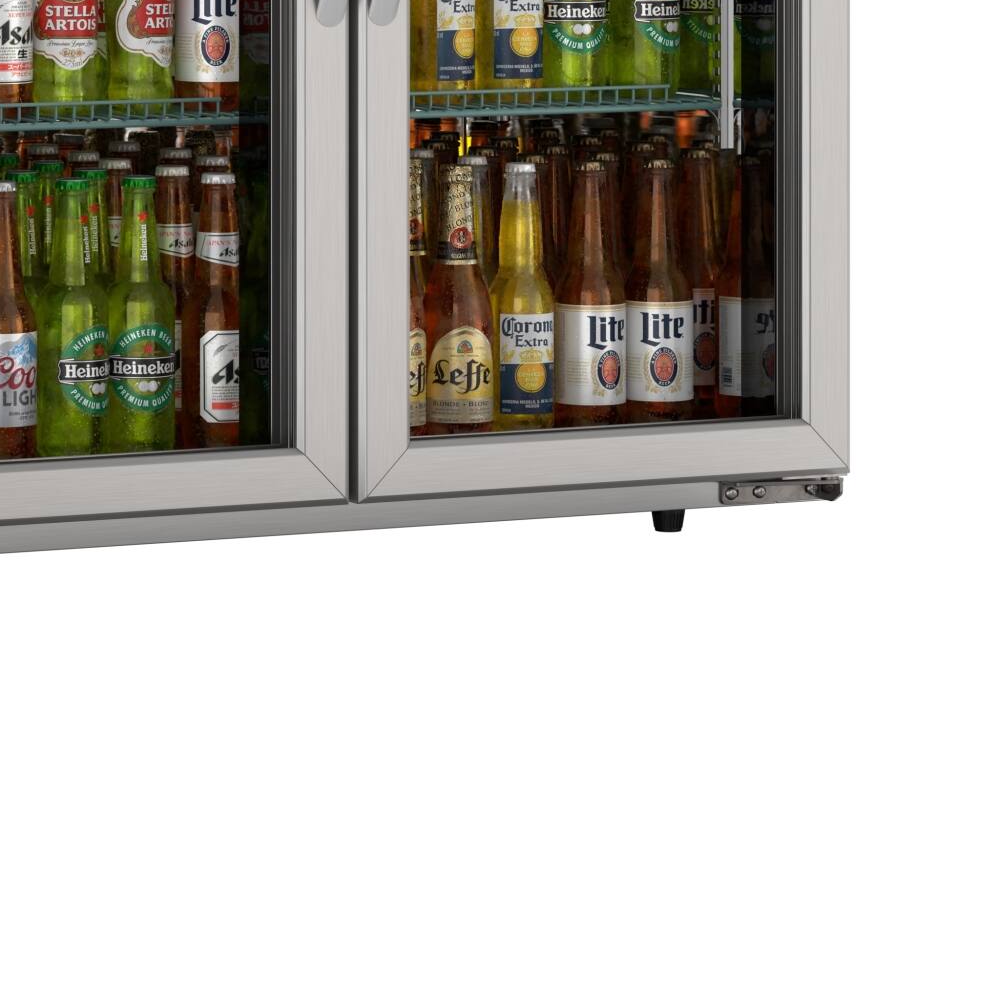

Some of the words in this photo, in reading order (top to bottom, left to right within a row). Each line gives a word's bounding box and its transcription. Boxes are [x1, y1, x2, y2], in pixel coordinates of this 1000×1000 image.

[45, 4, 96, 17] STELLA
[509, 0, 540, 12] Extra
[44, 18, 96, 31] ARTOIS
[552, 27, 584, 49] PREMIUM
[120, 328, 156, 348] HEINEKEN
[587, 315, 625, 350] Lite
[640, 311, 685, 347] Lite
[515, 334, 548, 348] Extra
[112, 360, 175, 375] Heineken
[432, 358, 491, 395] Leffe
[71, 388, 100, 409] PREMIUM
[118, 385, 149, 407] PREMIUM
